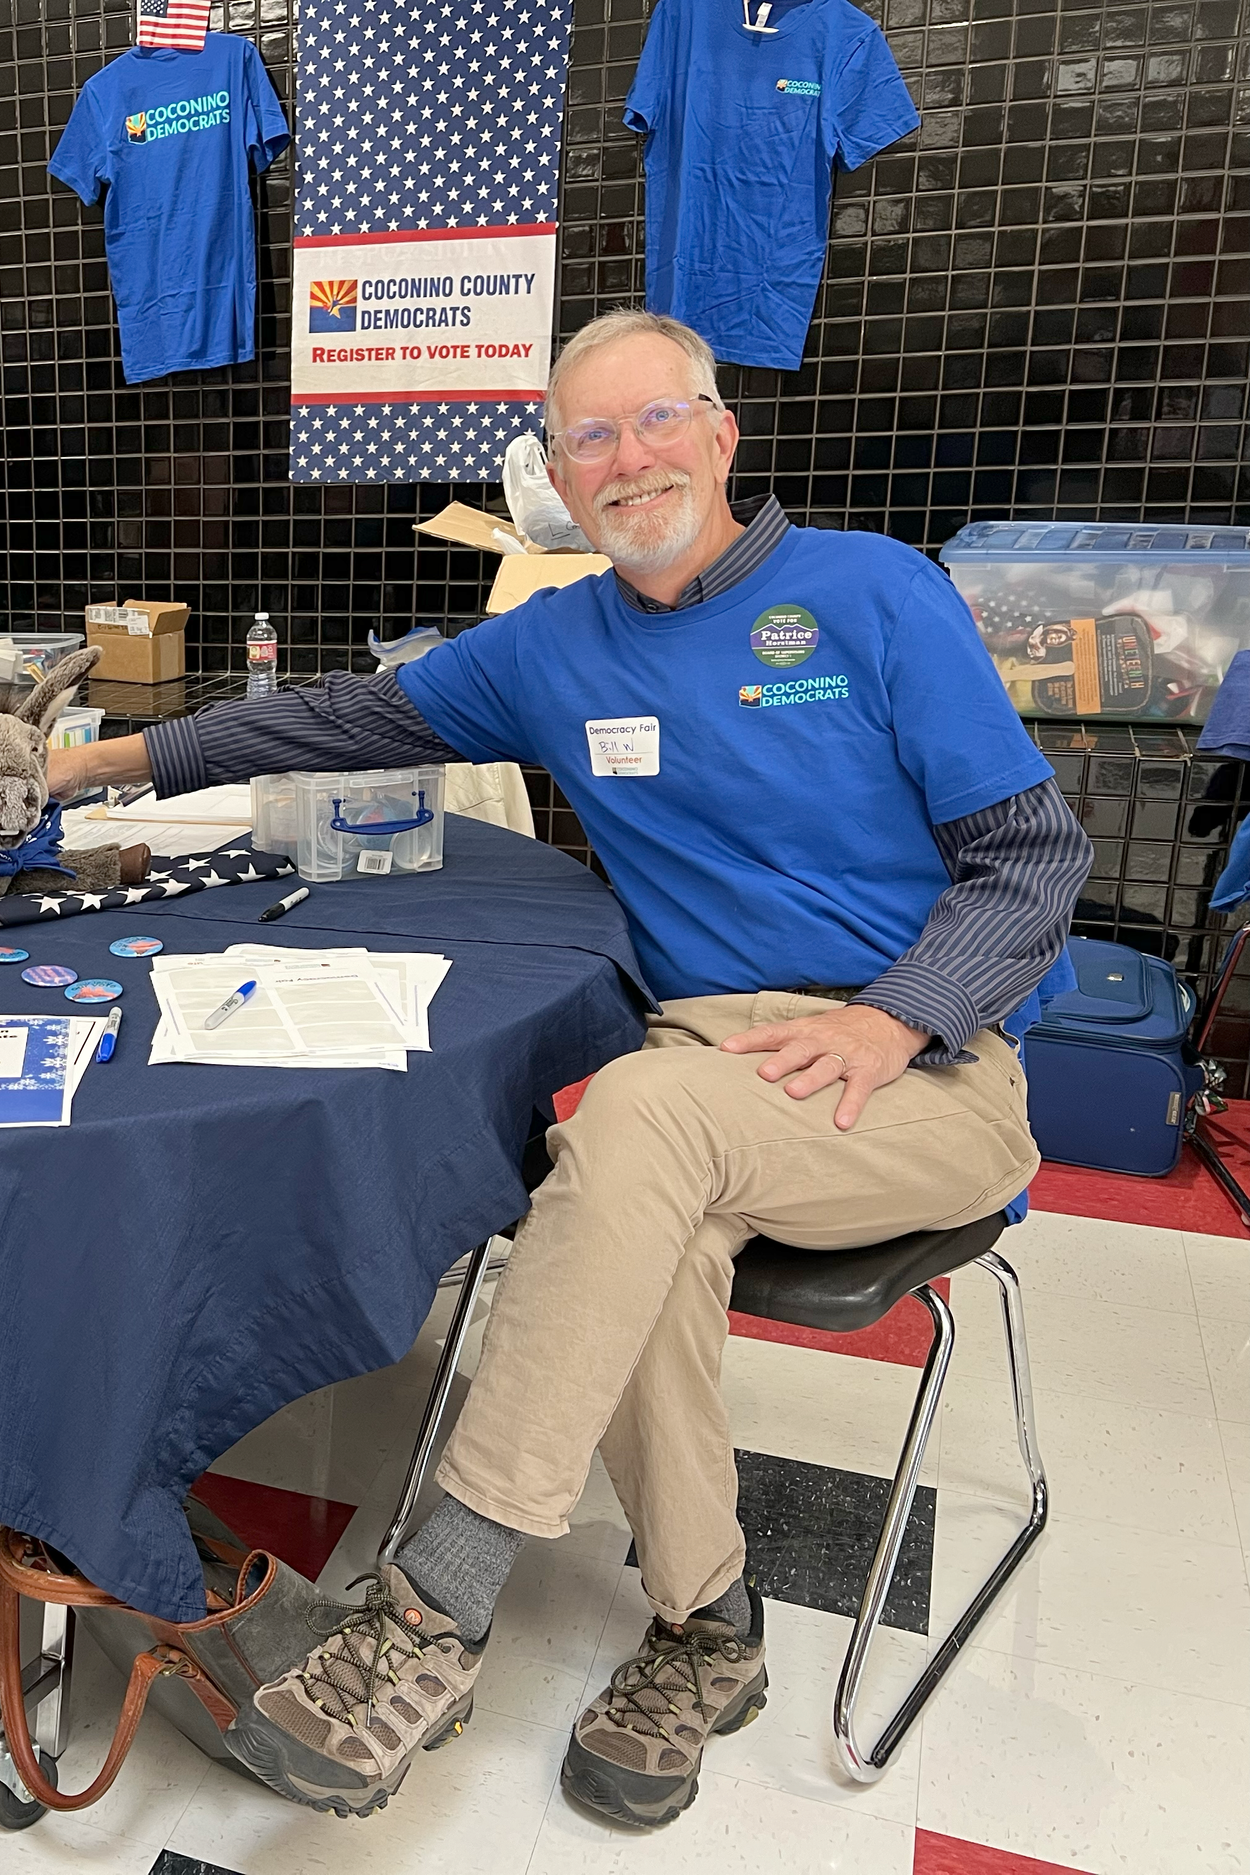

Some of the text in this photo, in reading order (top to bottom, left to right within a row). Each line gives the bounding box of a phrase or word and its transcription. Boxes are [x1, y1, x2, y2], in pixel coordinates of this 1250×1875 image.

[145, 91, 230, 125] COCONINO
[146, 109, 231, 142] DEMOCRATS
[361, 273, 536, 301] COCONINO COUNTY
[360, 306, 472, 331] DEMOCRATS
[400, 346, 422, 360] TO
[426, 345, 471, 360] VOTE
[474, 343, 534, 358] TODAY
[761, 630, 813, 641] Patrice
[762, 675, 848, 696] COCONINO
[762, 688, 849, 707] DEMOCRATS
[589, 723, 656, 735] Democracy Fair
[606, 756, 642, 764] Volunteer
